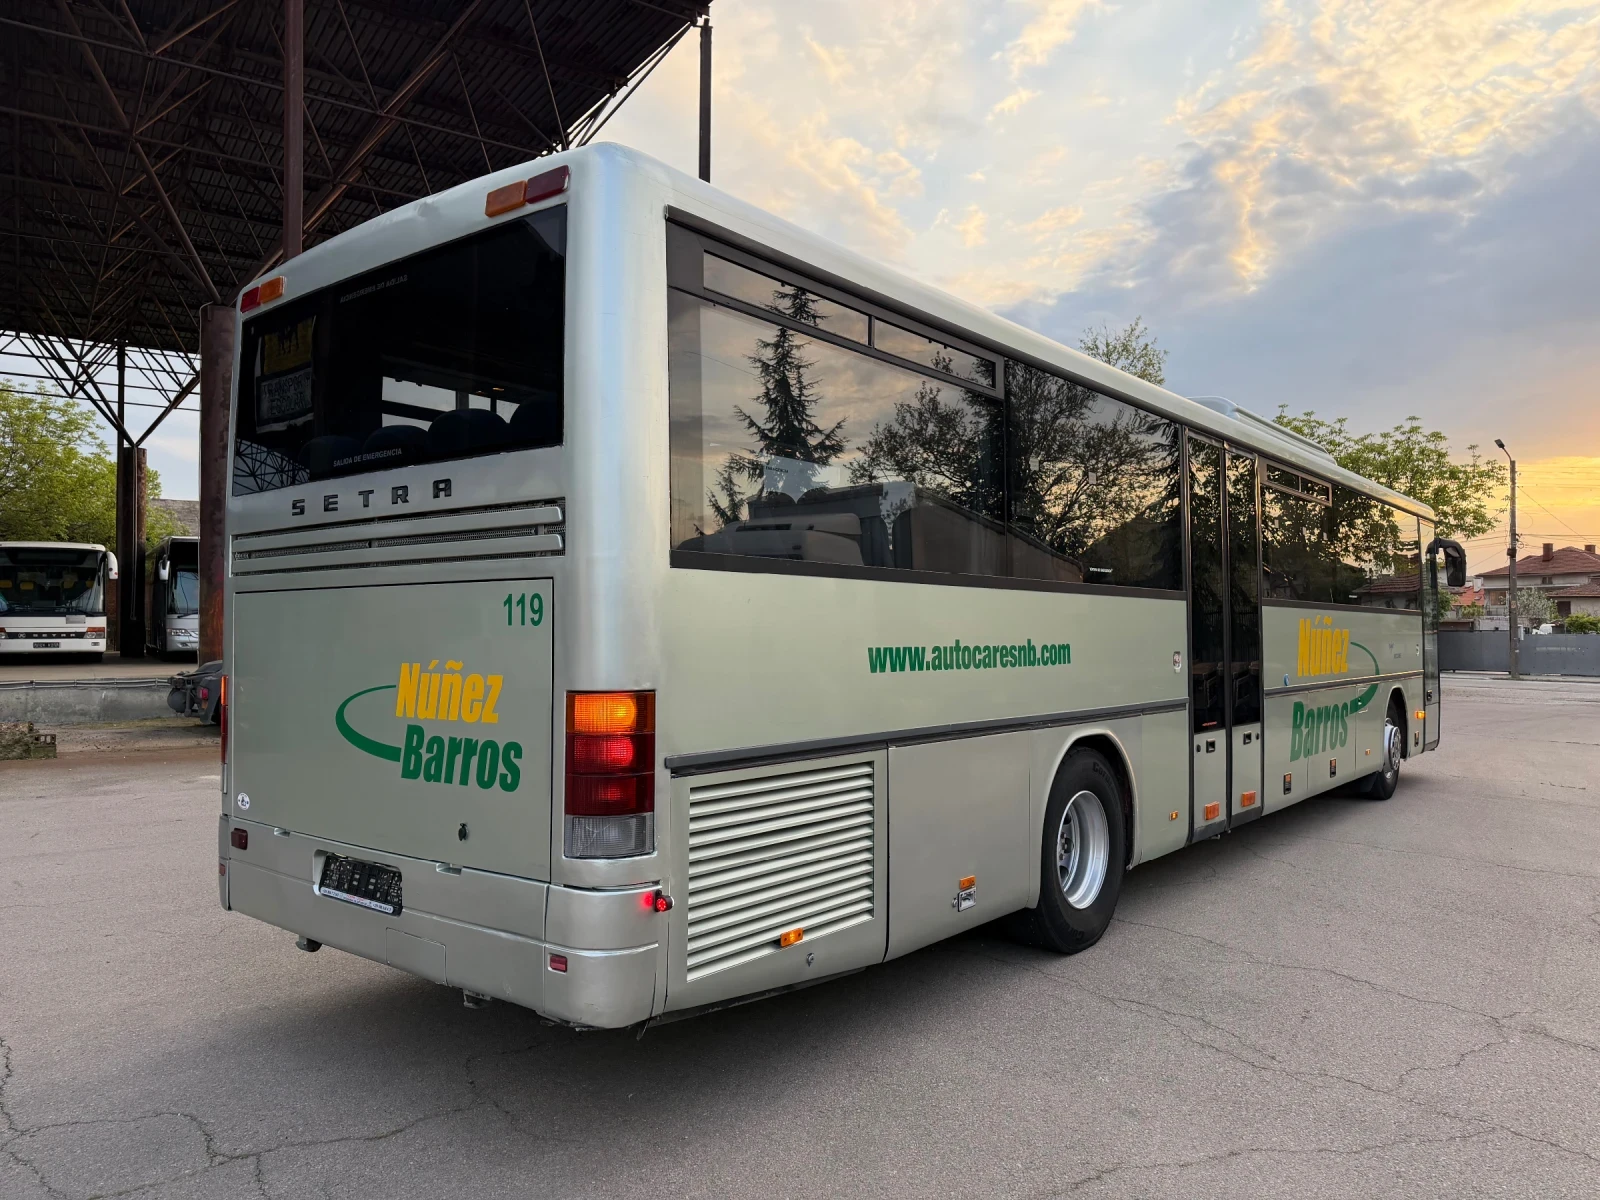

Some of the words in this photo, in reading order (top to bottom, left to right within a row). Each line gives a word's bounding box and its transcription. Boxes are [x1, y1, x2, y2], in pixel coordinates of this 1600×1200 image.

[333, 457, 353, 467] SALIDA
[353, 454, 362, 463] DE
[362, 448, 403, 461] EMERGENCIA
[291, 478, 453, 516] SETRA
[503, 592, 544, 627] 119
[867, 638, 1072, 673] www.autocaresnb.com
[1297, 615, 1350, 677] Núñez
[395, 659, 503, 724] Núñez
[1289, 700, 1349, 762] Barros
[400, 723, 524, 793] Barros
